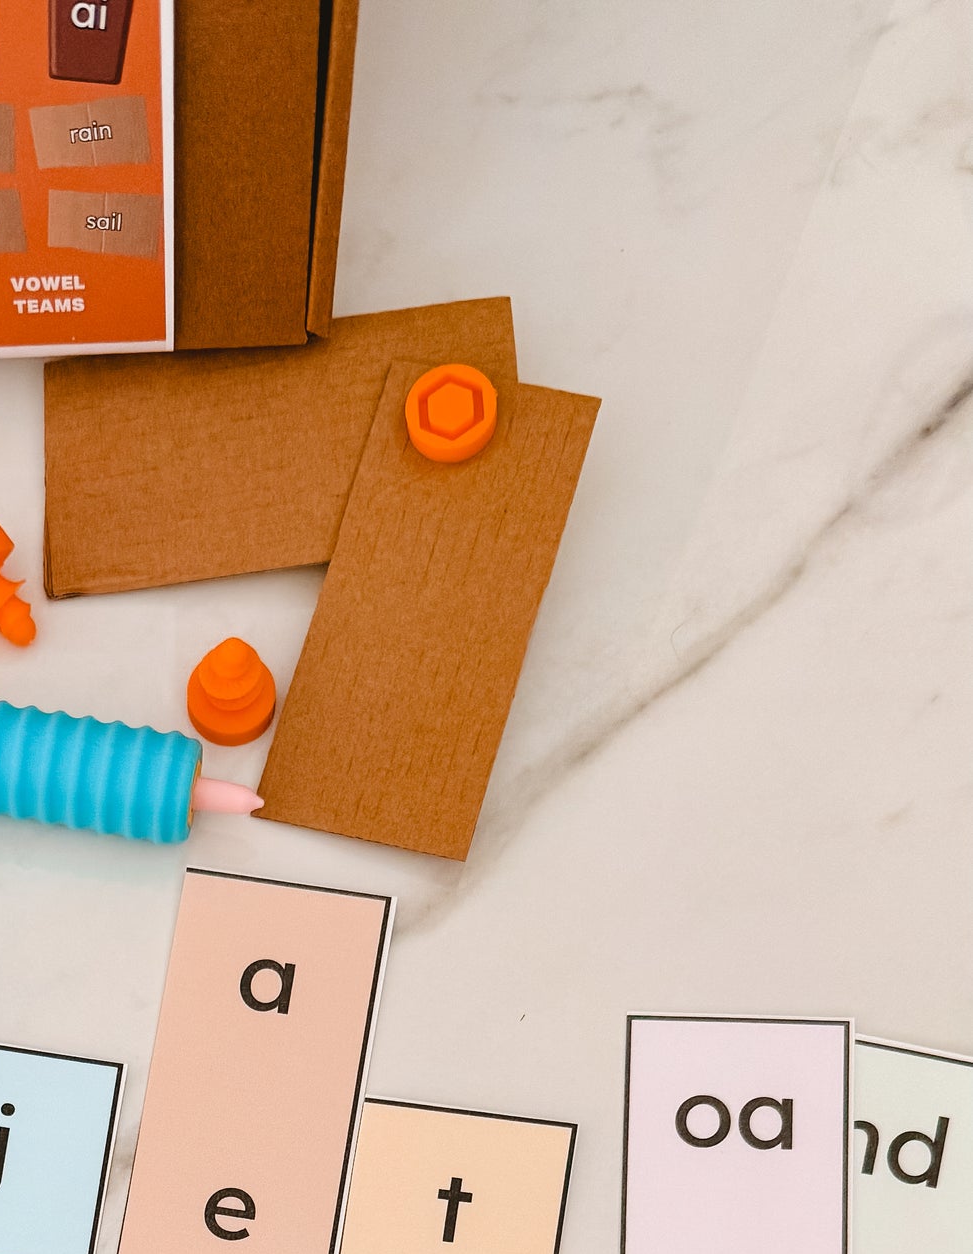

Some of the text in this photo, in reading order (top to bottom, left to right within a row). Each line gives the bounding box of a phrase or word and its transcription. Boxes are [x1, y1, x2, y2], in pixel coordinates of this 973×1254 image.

[70, 0, 108, 31] ai
[69, 120, 113, 144] rain
[85, 212, 123, 232] sail
[10, 275, 86, 293] VOWEL
[13, 297, 86, 315] TEAMS
[239, 958, 297, 1016] a
[674, 1094, 794, 1151] oa
[203, 1186, 257, 1242] e
[437, 1176, 474, 1244] t
